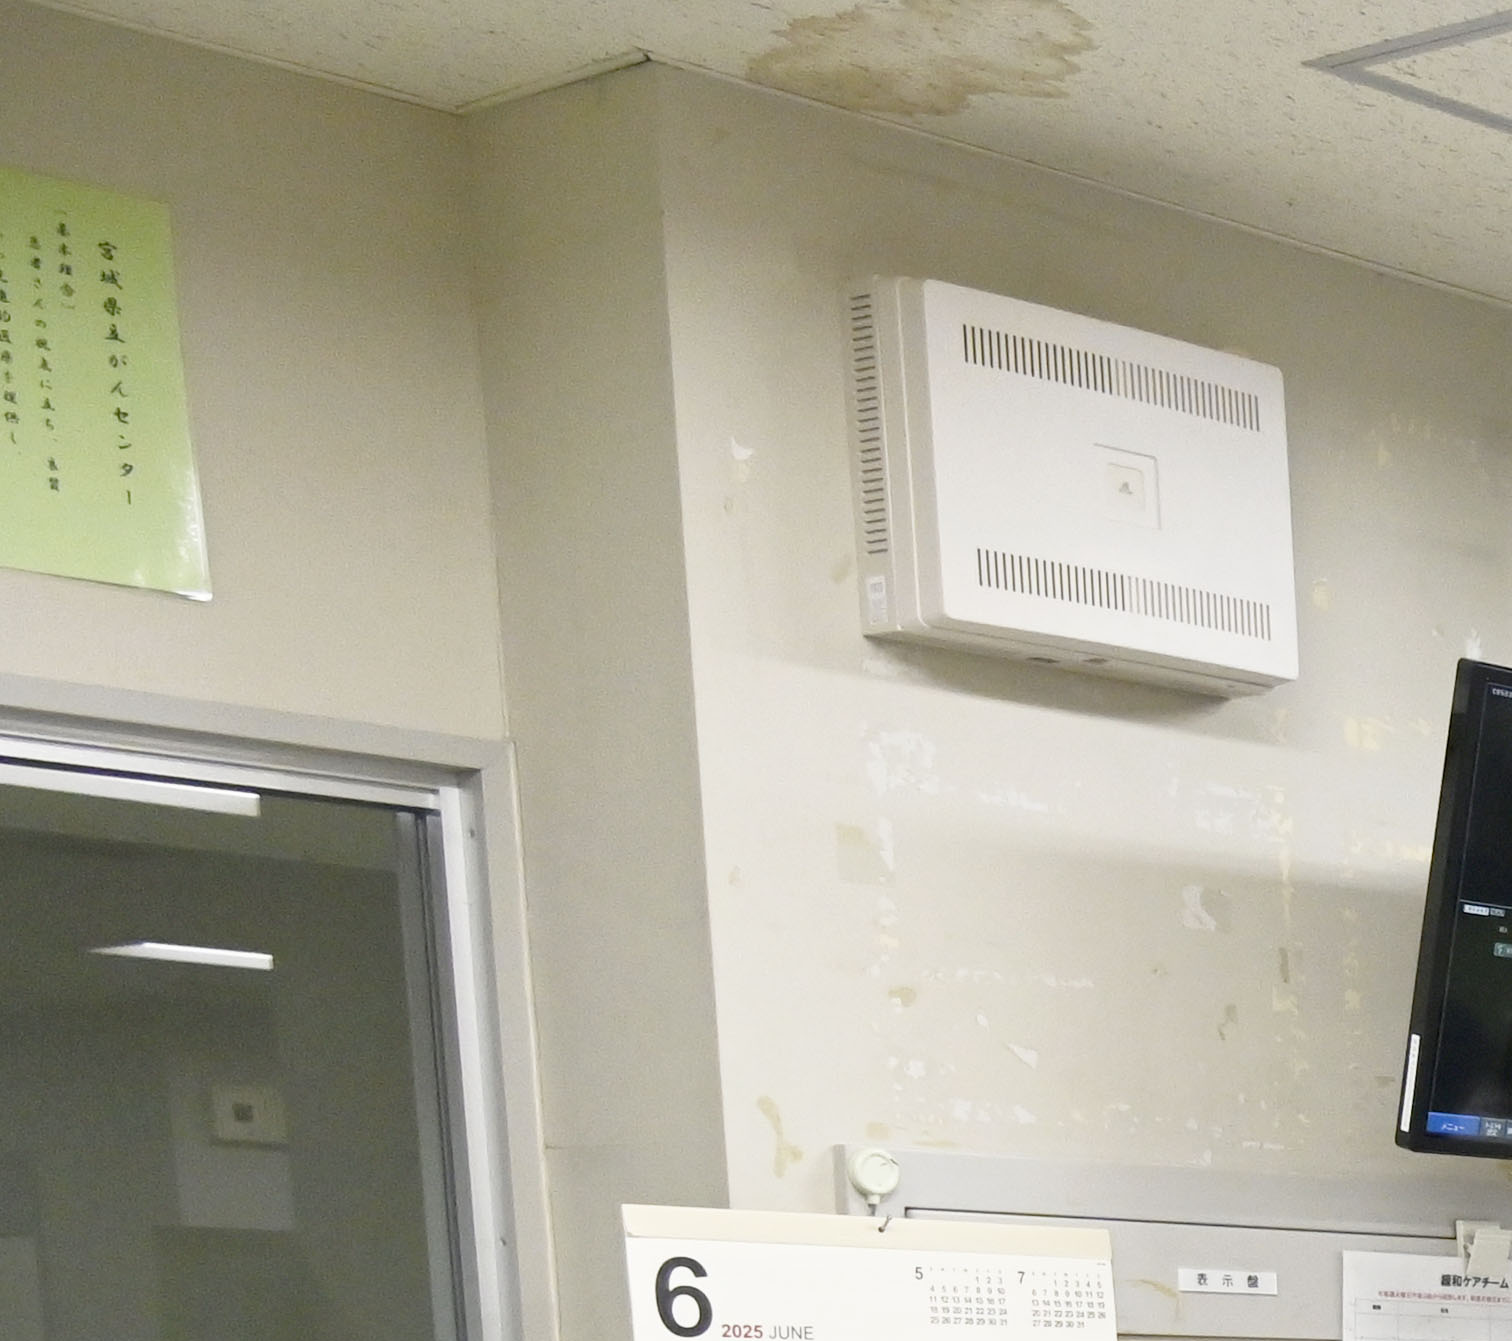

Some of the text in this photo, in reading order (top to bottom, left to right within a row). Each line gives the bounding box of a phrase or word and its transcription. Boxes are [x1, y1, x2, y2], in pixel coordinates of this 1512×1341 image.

[97, 240, 134, 506] 宮城県立がんセンター
[916, 1267, 923, 1280] 5
[1018, 1271, 1025, 1283] 7
[1197, 1272, 1260, 1288] 表示盤
[1440, 1273, 1510, 1290] 緩和ケアチーム
[655, 1257, 712, 1337] 6
[722, 1324, 813, 1340] 2025 JUNE
